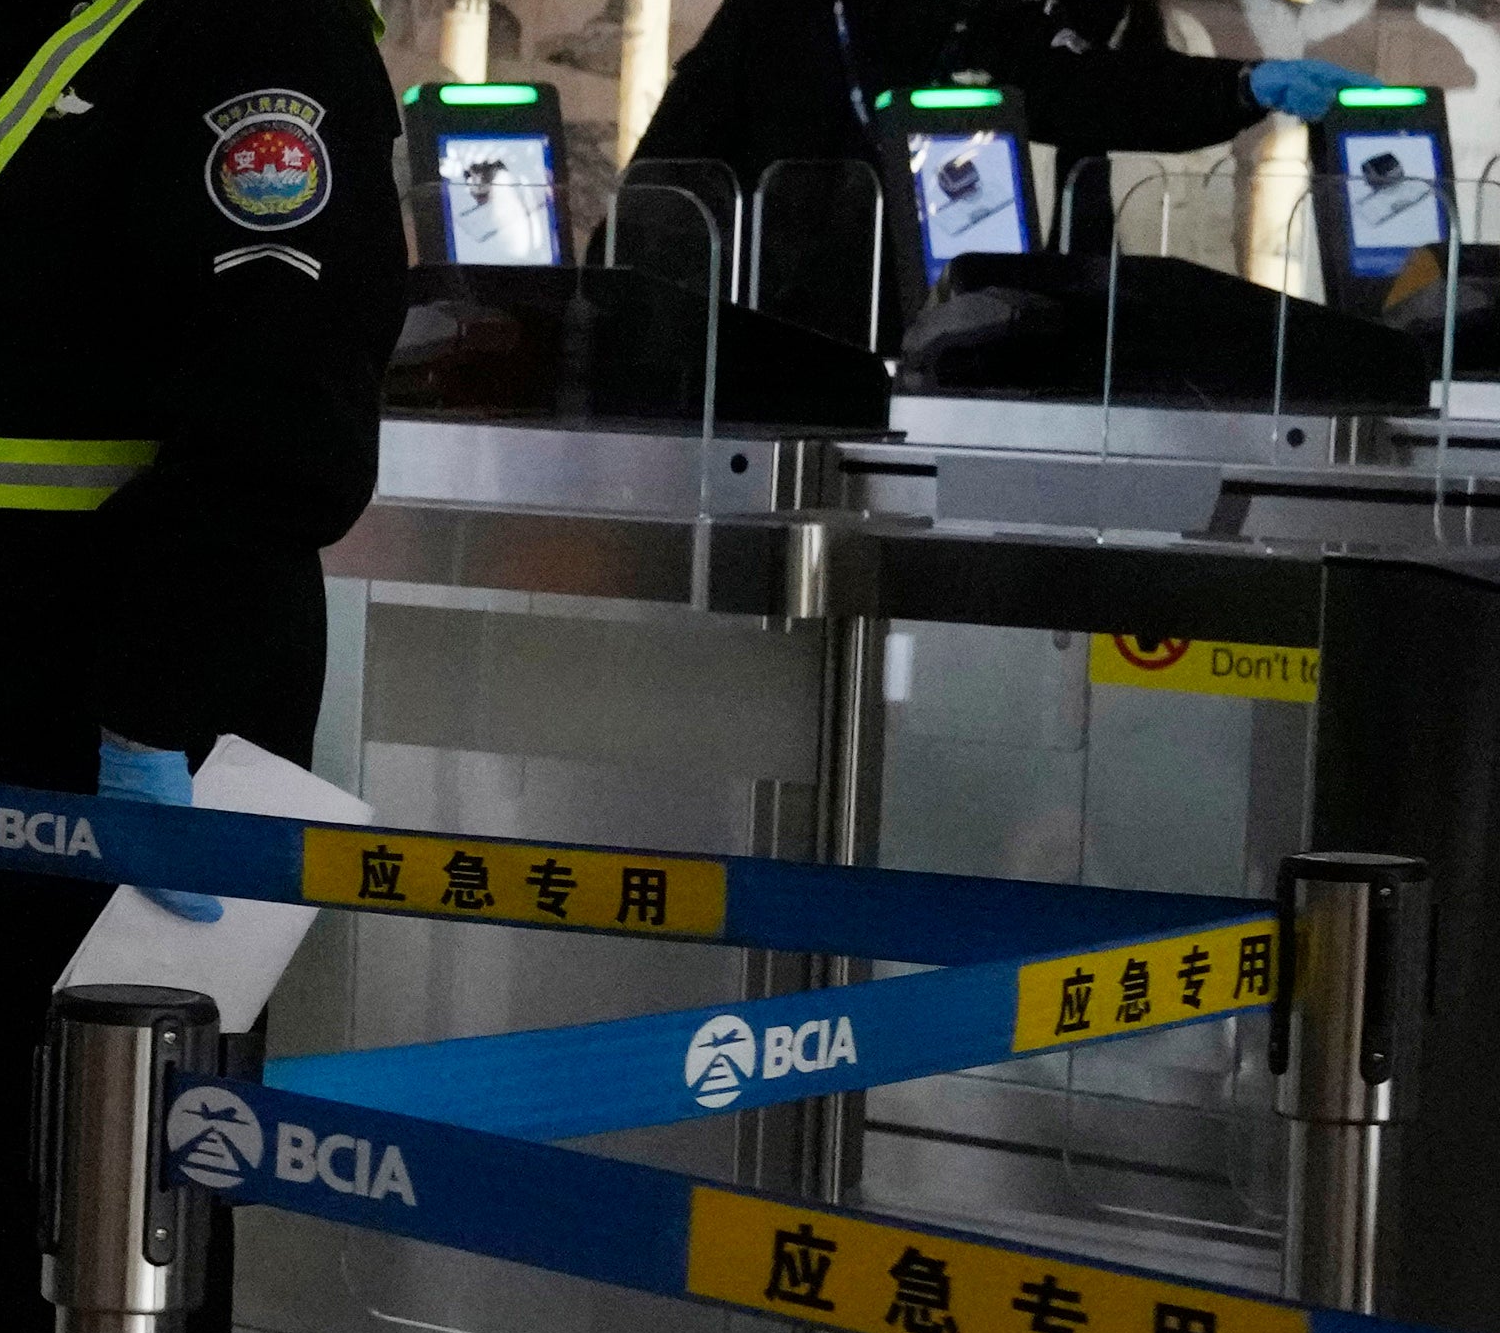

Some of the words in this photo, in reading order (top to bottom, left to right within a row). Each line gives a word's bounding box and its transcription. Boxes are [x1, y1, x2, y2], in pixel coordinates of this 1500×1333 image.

[1211, 647, 1288, 682] Don't
[357, 844, 668, 926] 应急专用
[1053, 932, 1274, 1038] 应急专用
[762, 1015, 858, 1080] BCIA
[274, 1121, 418, 1207] BCIA
